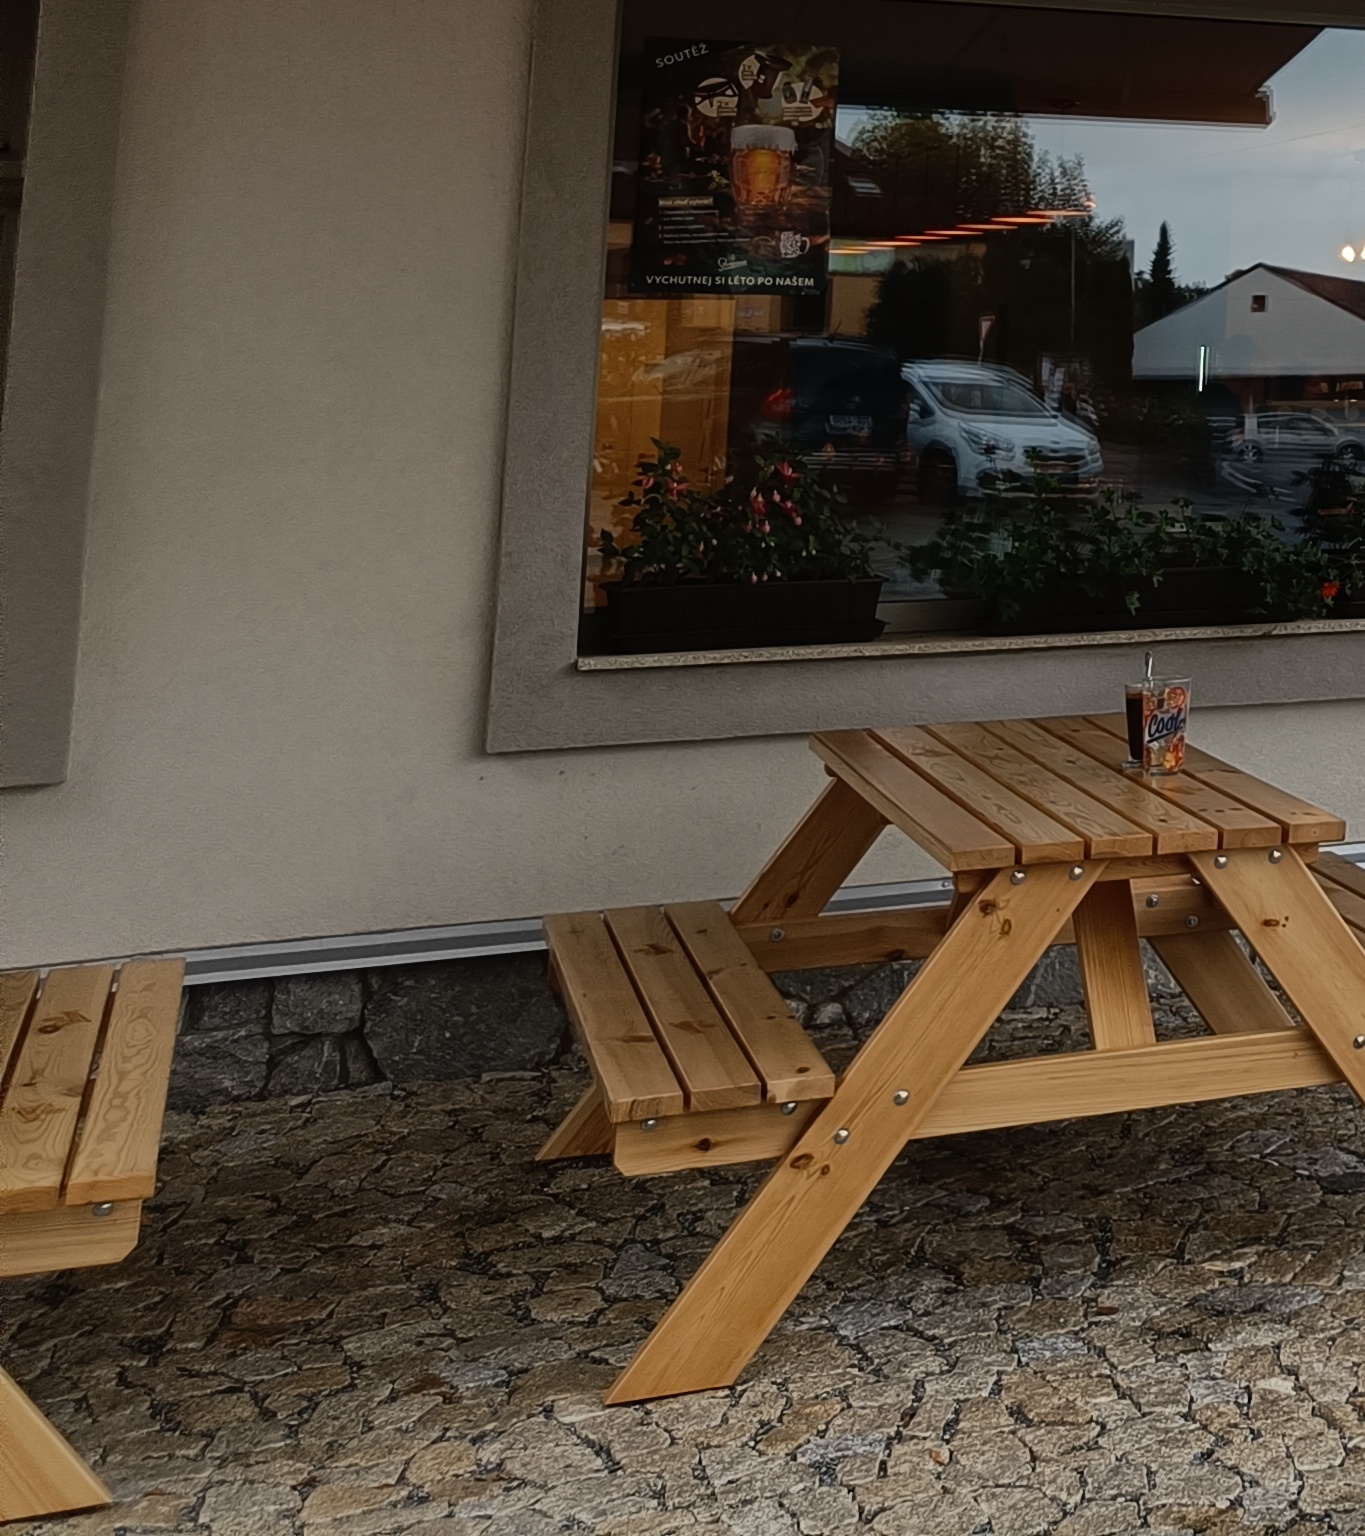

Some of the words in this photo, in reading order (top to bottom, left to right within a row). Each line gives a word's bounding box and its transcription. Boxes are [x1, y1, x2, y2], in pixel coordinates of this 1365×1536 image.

[655, 42, 709, 68] SOUTĚŽ
[646, 275, 712, 286] VYCHUTNEJ
[715, 276, 725, 285] SI
[728, 274, 755, 286] LÉTO
[757, 275, 773, 286] PO
[775, 275, 815, 287] NAŠEM
